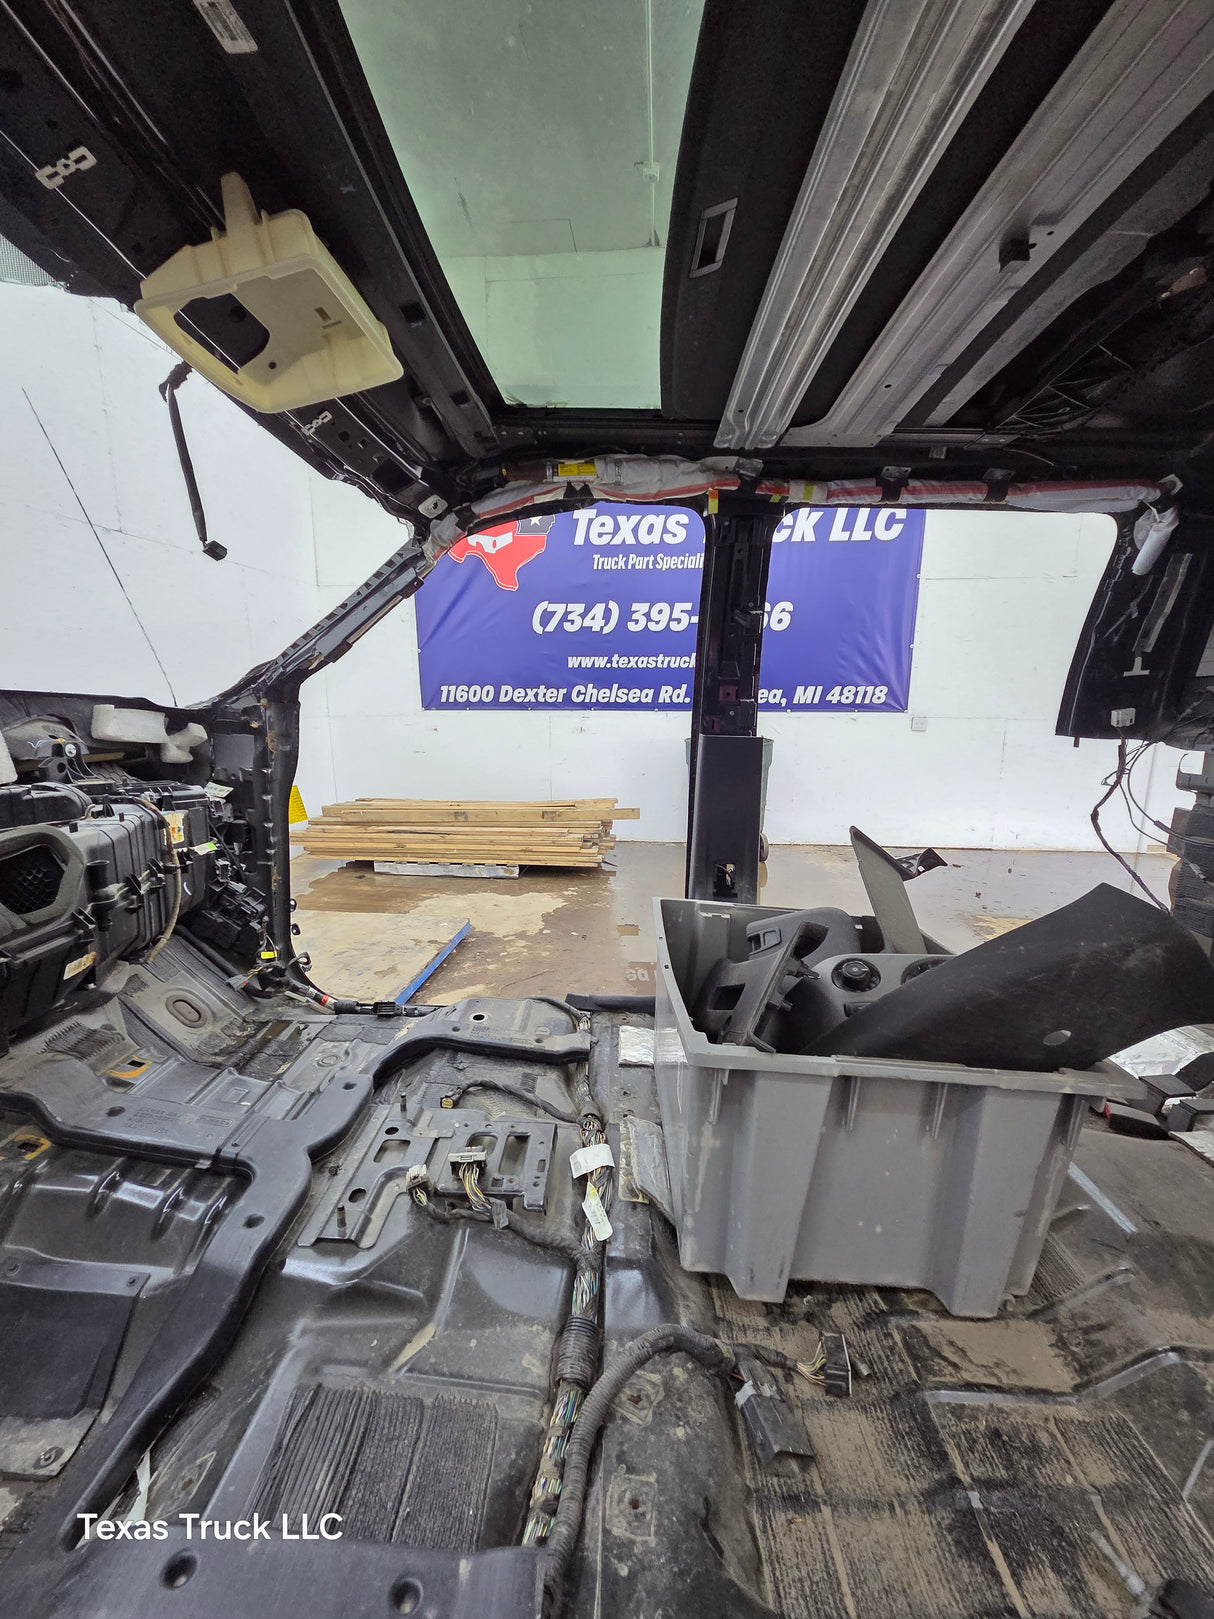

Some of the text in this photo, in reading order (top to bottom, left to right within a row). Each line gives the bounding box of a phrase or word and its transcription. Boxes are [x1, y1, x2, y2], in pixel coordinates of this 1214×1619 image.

[572, 508, 690, 546] Texas
[828, 507, 908, 542] LLC
[592, 552, 705, 572] Truck Part Speciali
[532, 600, 620, 635] (734)
[567, 652, 697, 669] www.texastruck
[440, 684, 495, 703] 11600
[498, 685, 568, 703] Dexter
[571, 683, 655, 703] Chelsea
[657, 683, 691, 704] Rd.
[792, 685, 824, 704] MI
[825, 685, 889, 705] 48118
